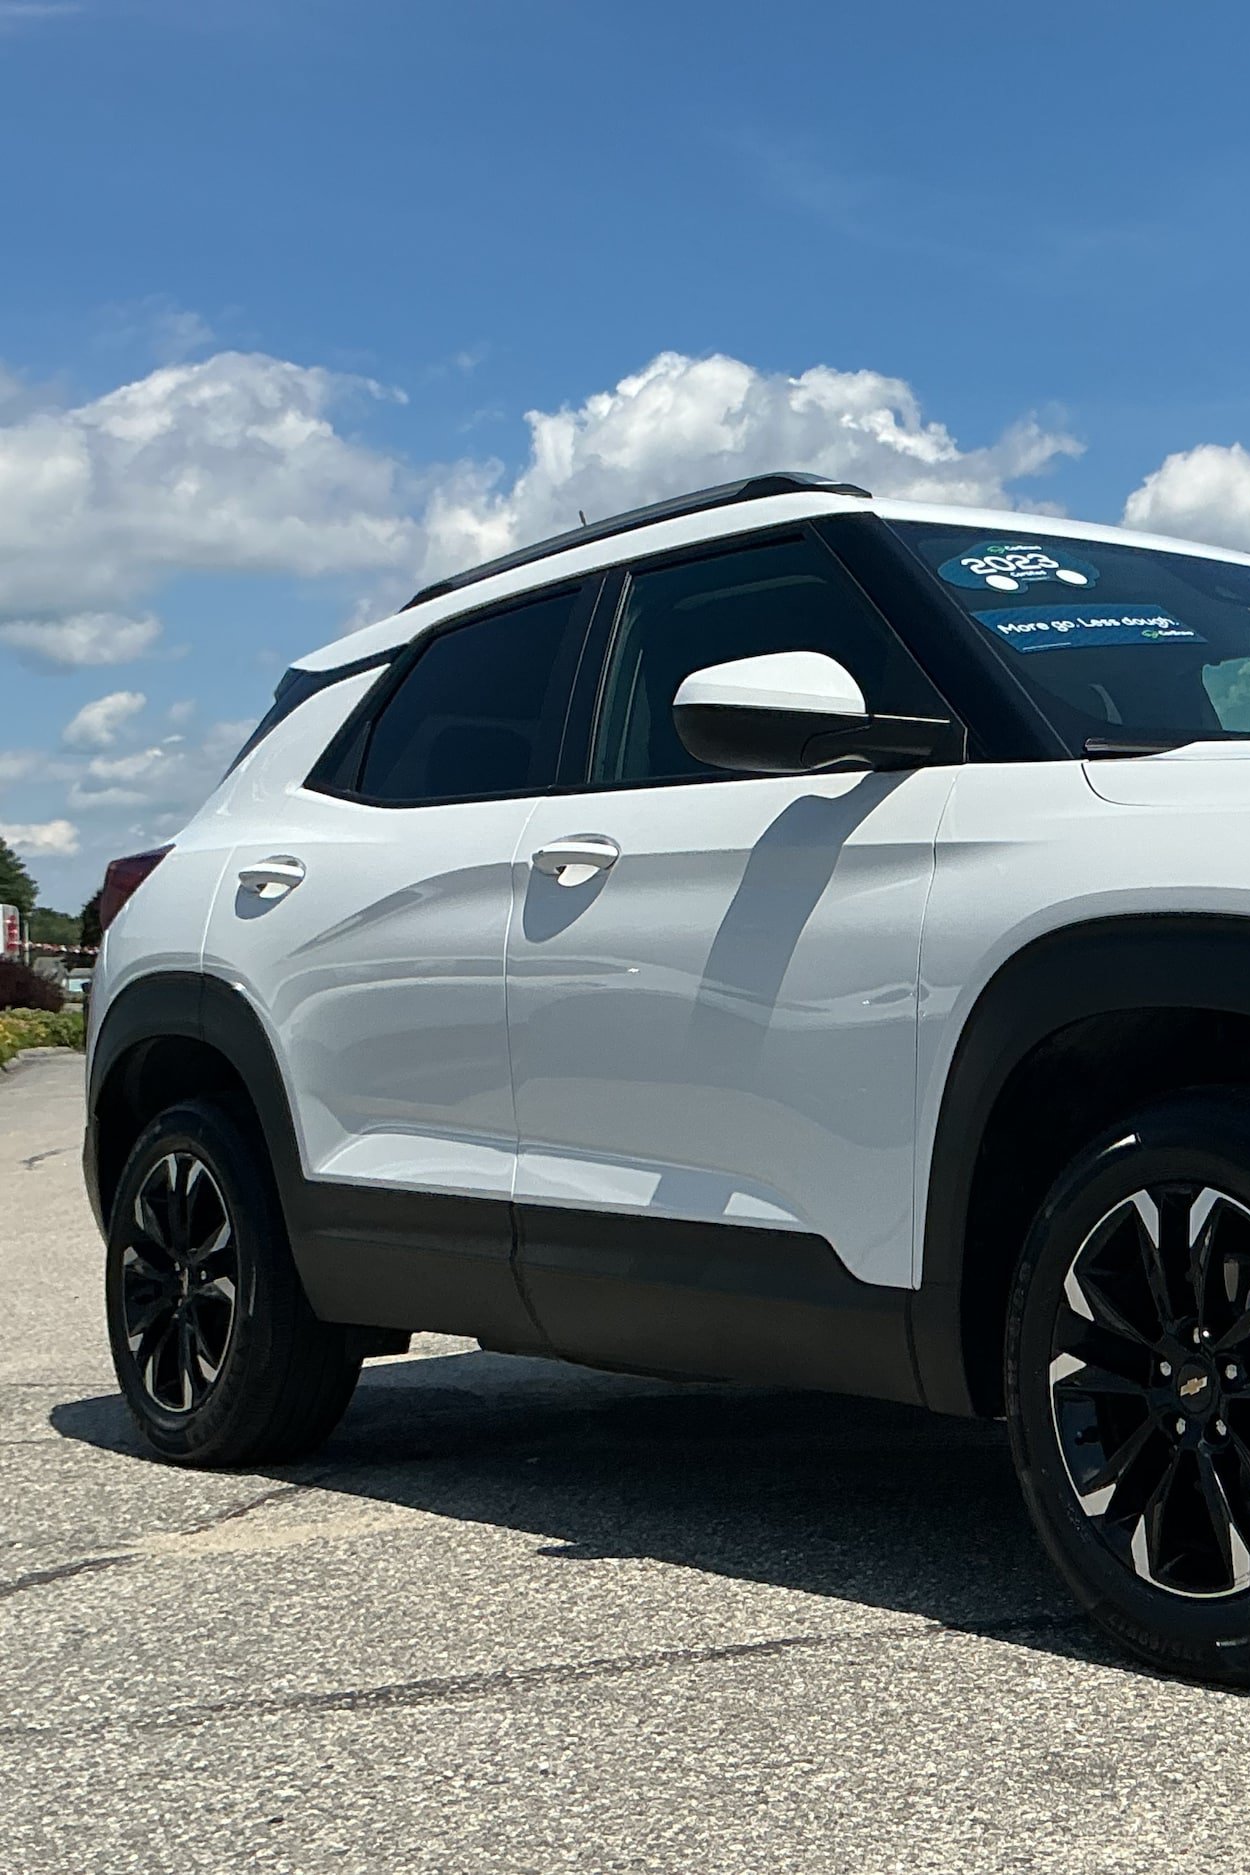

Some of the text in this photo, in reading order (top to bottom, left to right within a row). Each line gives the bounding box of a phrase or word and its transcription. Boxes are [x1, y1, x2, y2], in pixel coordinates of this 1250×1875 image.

[960, 553, 1060, 575] 2023
[997, 615, 1180, 636] More go. Less dough.
